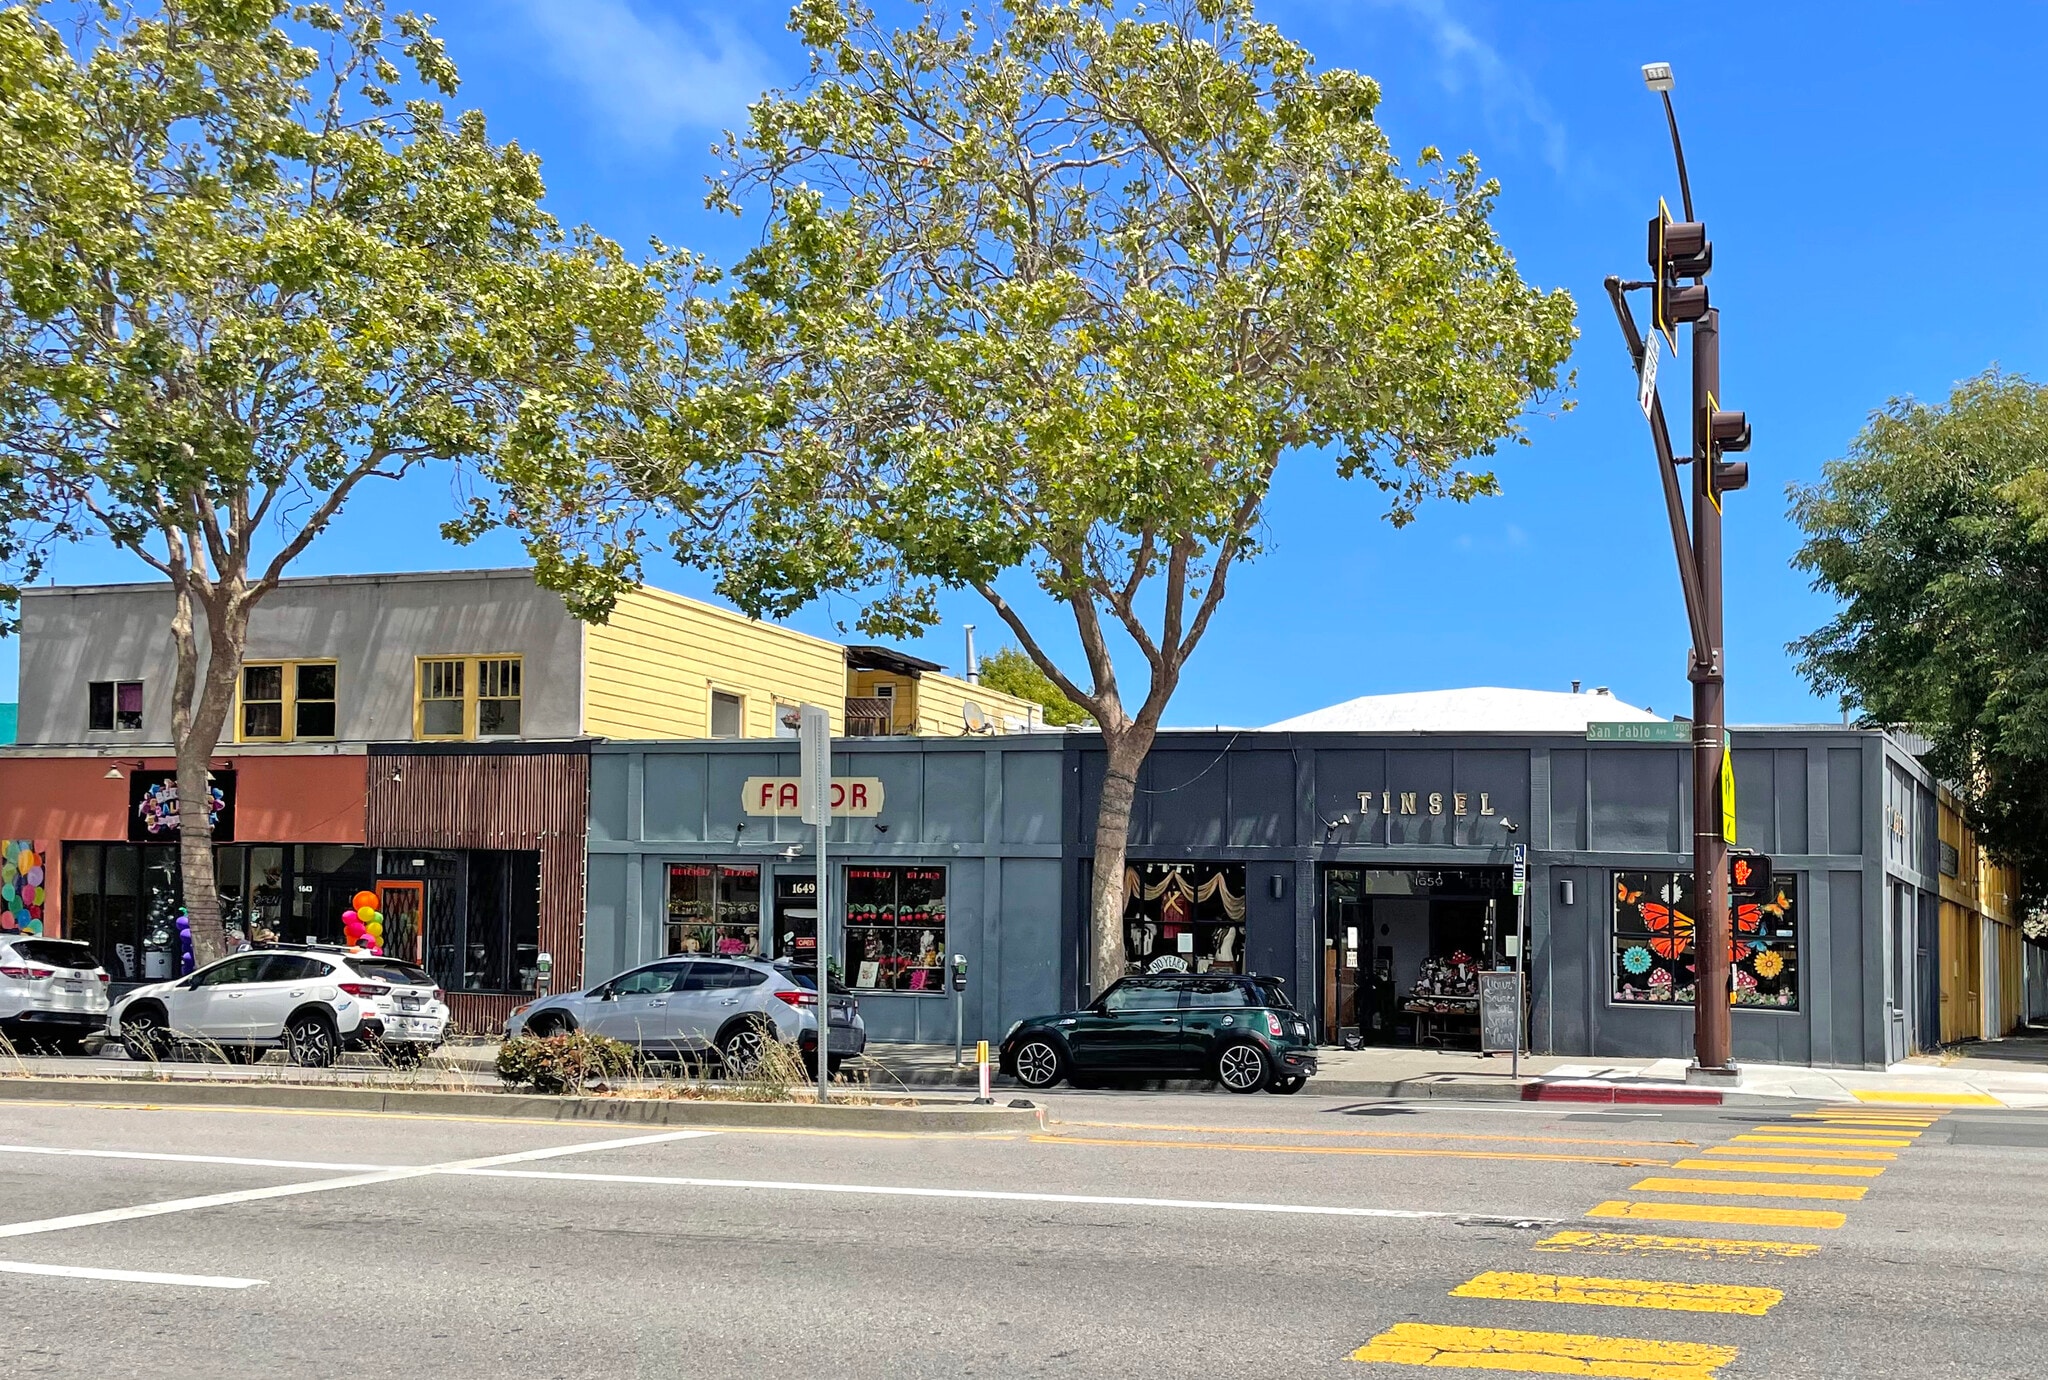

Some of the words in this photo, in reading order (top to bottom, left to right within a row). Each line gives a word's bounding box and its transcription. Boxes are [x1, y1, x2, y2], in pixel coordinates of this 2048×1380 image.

[1589, 724, 1611, 738] San
[1617, 724, 1651, 738] Pablo
[1655, 728, 1667, 736] Ave
[1672, 723, 1690, 732] 1700
[760, 783, 867, 808] FAOR
[1357, 791, 1495, 816] TINSEL
[792, 883, 816, 894] 1649
[1162, 956, 1186, 971] YEARS
